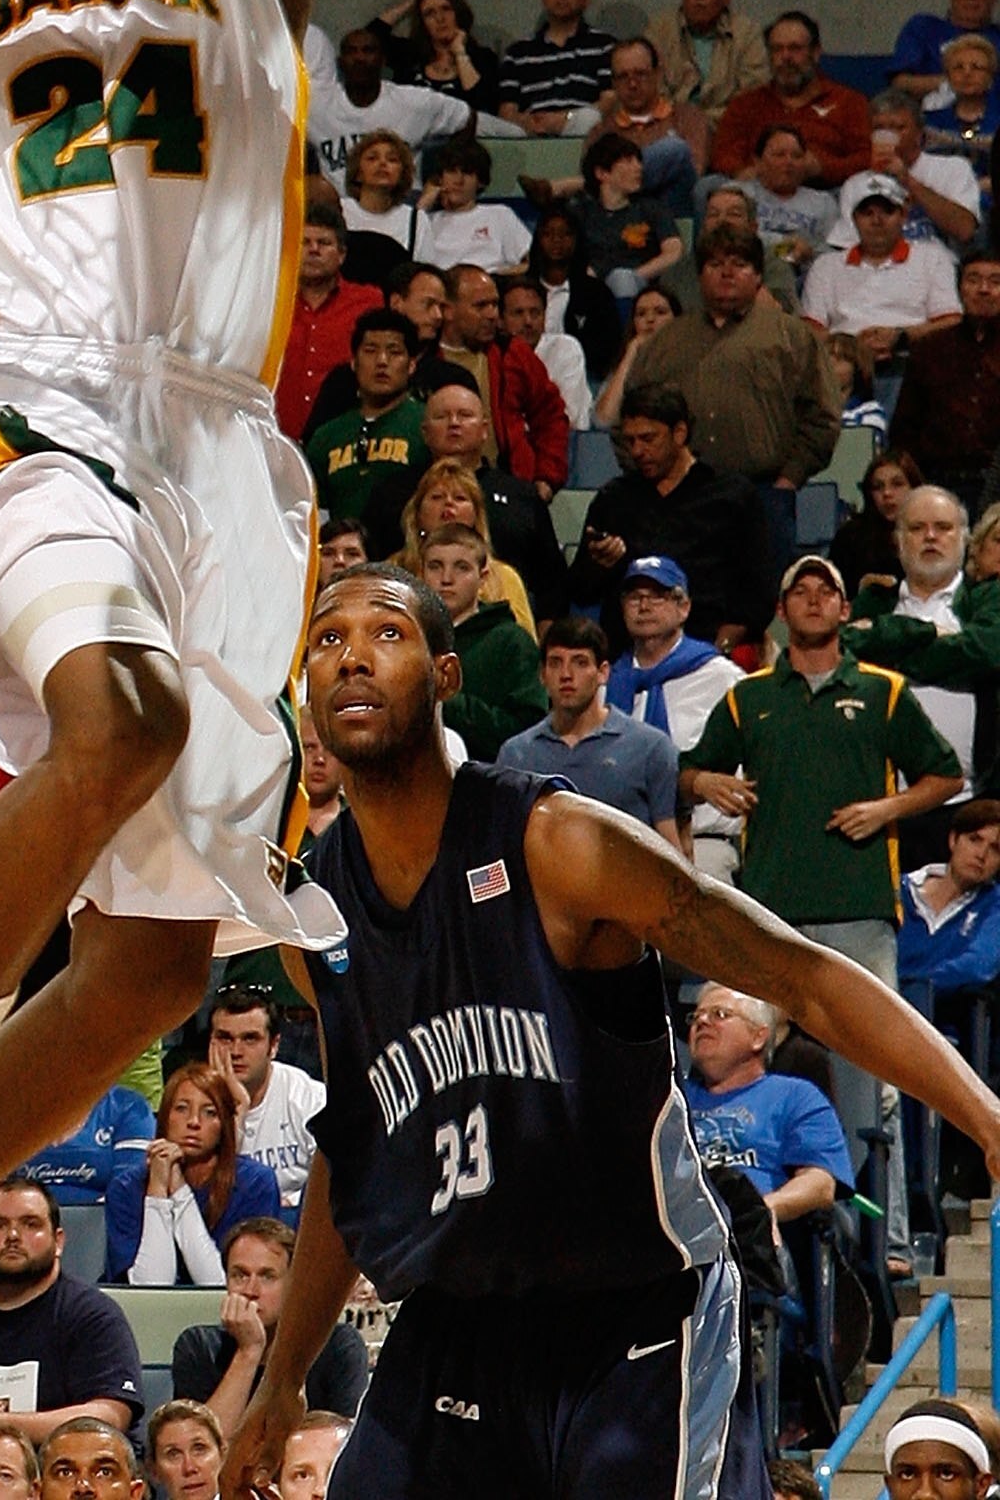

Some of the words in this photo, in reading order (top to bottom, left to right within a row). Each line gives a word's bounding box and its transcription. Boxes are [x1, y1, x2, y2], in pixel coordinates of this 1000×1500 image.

[4, 37, 210, 206] 24
[367, 1038, 421, 1138] OLD
[430, 1101, 496, 1217] 33
[435, 1396, 480, 1421] CAA
